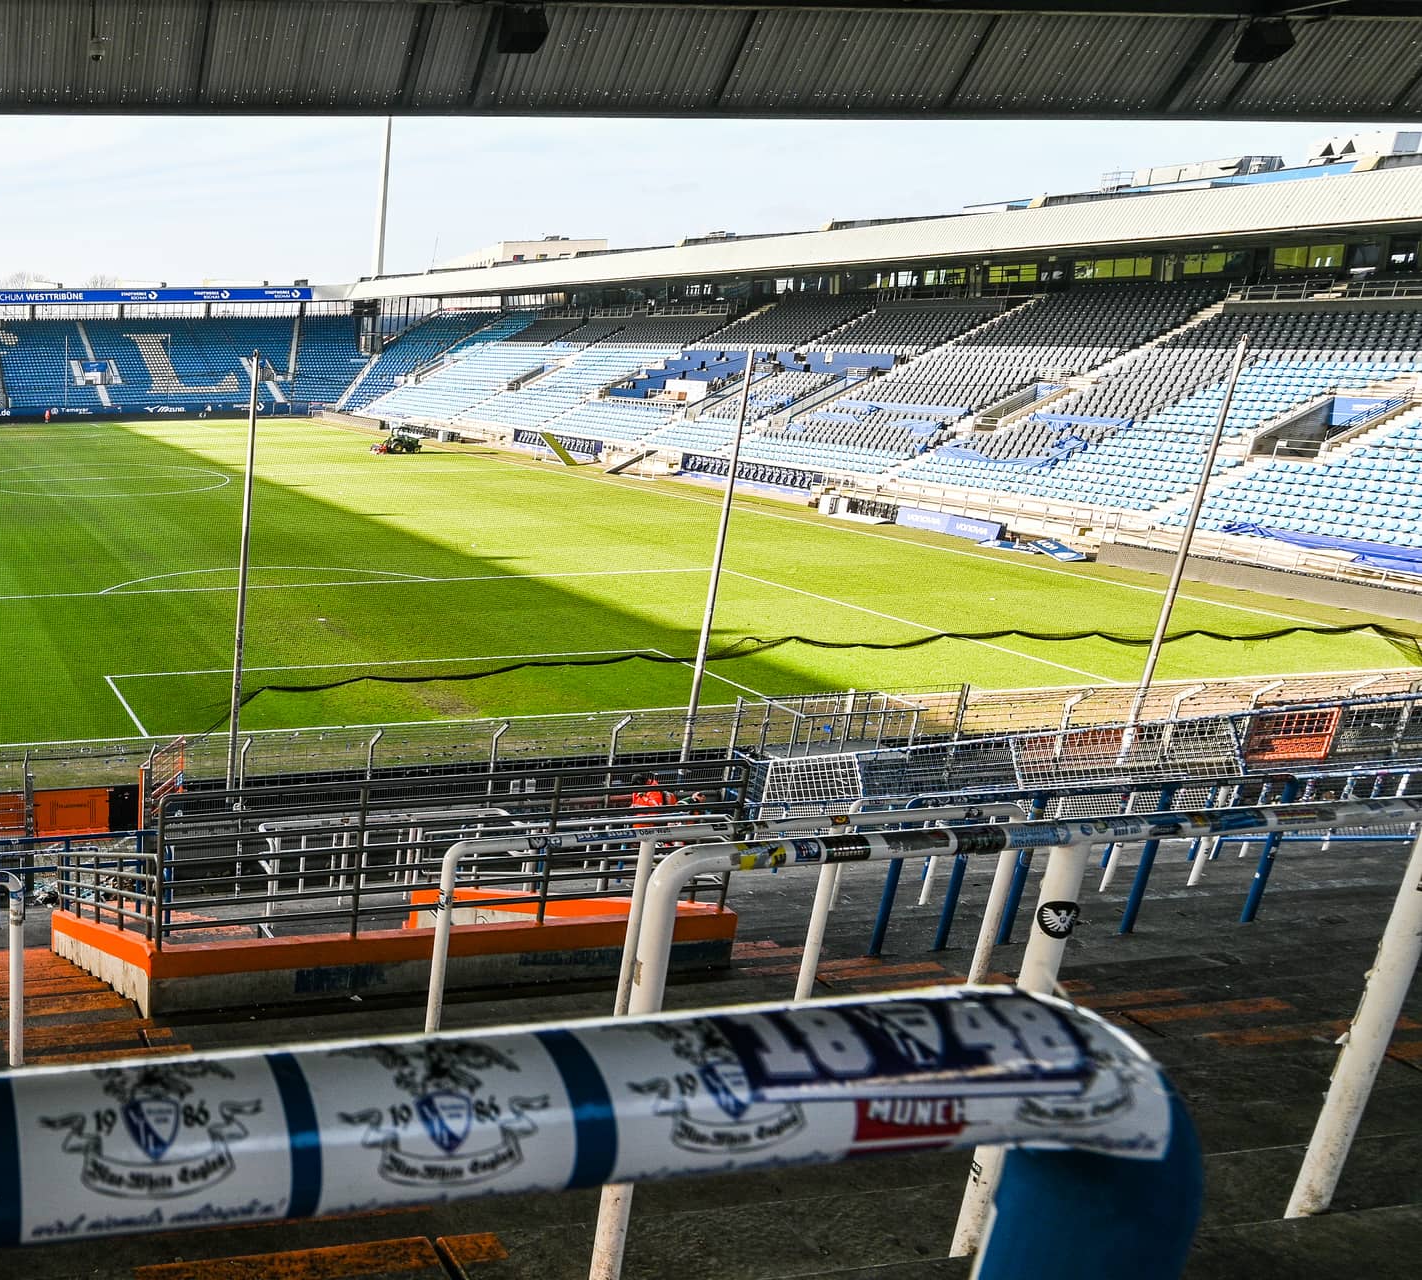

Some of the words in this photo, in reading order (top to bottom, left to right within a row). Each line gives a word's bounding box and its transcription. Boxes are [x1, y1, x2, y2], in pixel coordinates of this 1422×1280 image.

[25, 291, 84, 301] WESTTRIBÜNE
[736, 1008, 872, 1075] 18
[93, 1108, 117, 1135] 19
[182, 1100, 210, 1127] 86
